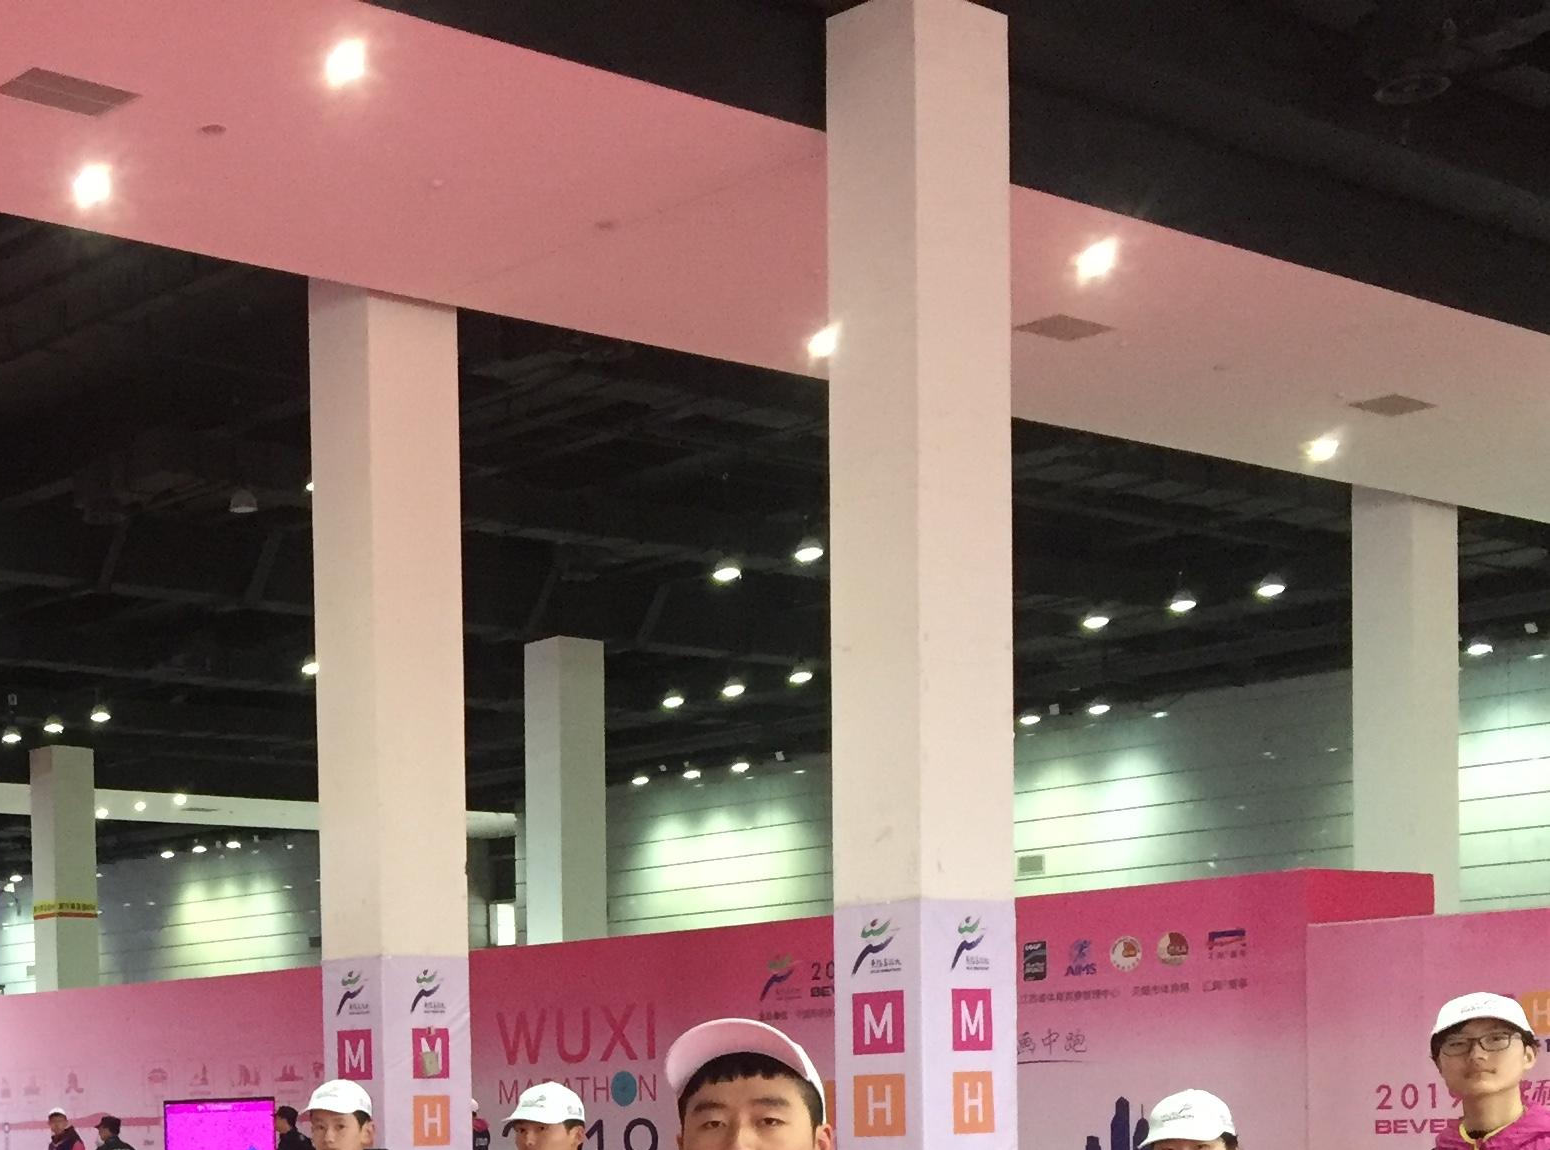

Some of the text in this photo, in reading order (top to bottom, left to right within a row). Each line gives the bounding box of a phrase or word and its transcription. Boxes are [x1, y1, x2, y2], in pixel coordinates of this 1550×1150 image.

[496, 1002, 657, 1065] WUXI
[863, 1002, 893, 1046] M
[960, 1000, 985, 1042] M
[344, 1038, 366, 1074] M
[423, 1103, 442, 1138] H
[867, 1084, 892, 1127] H
[963, 1081, 984, 1124] H
[1375, 1118, 1460, 1135] BEVE
